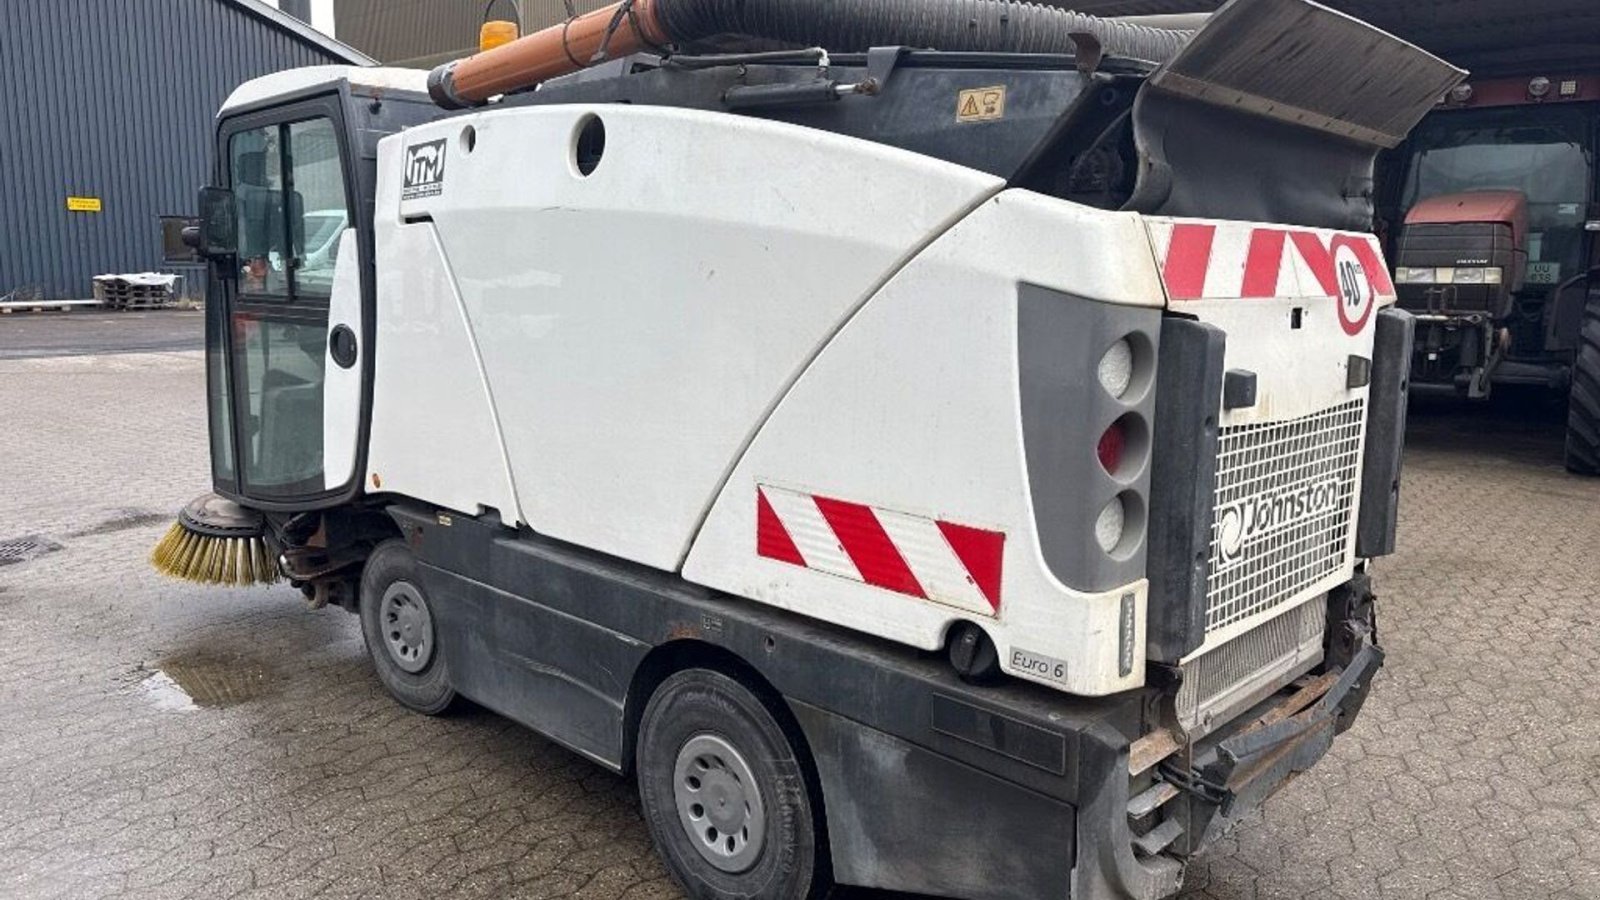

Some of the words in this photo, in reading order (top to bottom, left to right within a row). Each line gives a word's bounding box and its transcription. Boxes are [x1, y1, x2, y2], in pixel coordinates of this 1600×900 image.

[1339, 260, 1361, 307] 40
[1245, 480, 1339, 537] Johnston
[1012, 651, 1049, 674] Euro
[1054, 663, 1064, 678] 6
